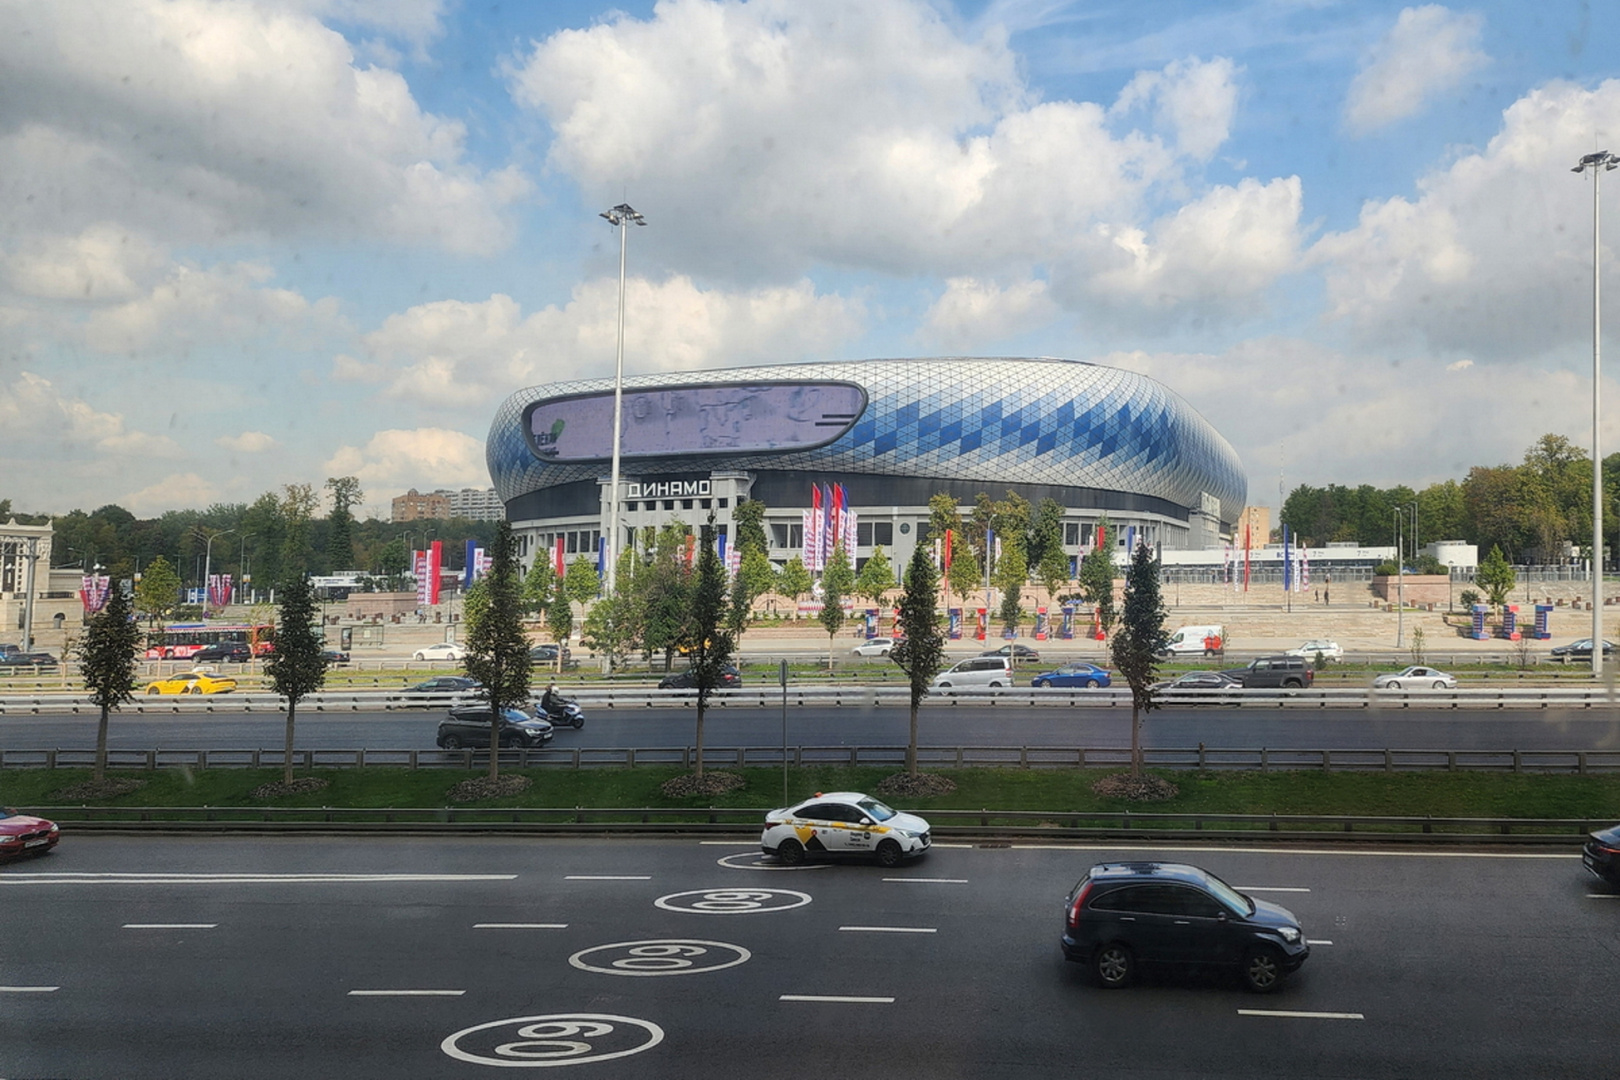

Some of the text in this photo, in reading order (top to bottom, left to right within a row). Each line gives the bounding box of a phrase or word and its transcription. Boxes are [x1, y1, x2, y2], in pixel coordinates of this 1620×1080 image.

[628, 480, 710, 498] ДИНАМО
[691, 892, 773, 910] 60
[612, 944, 707, 970] 60
[495, 1021, 614, 1058] 60
